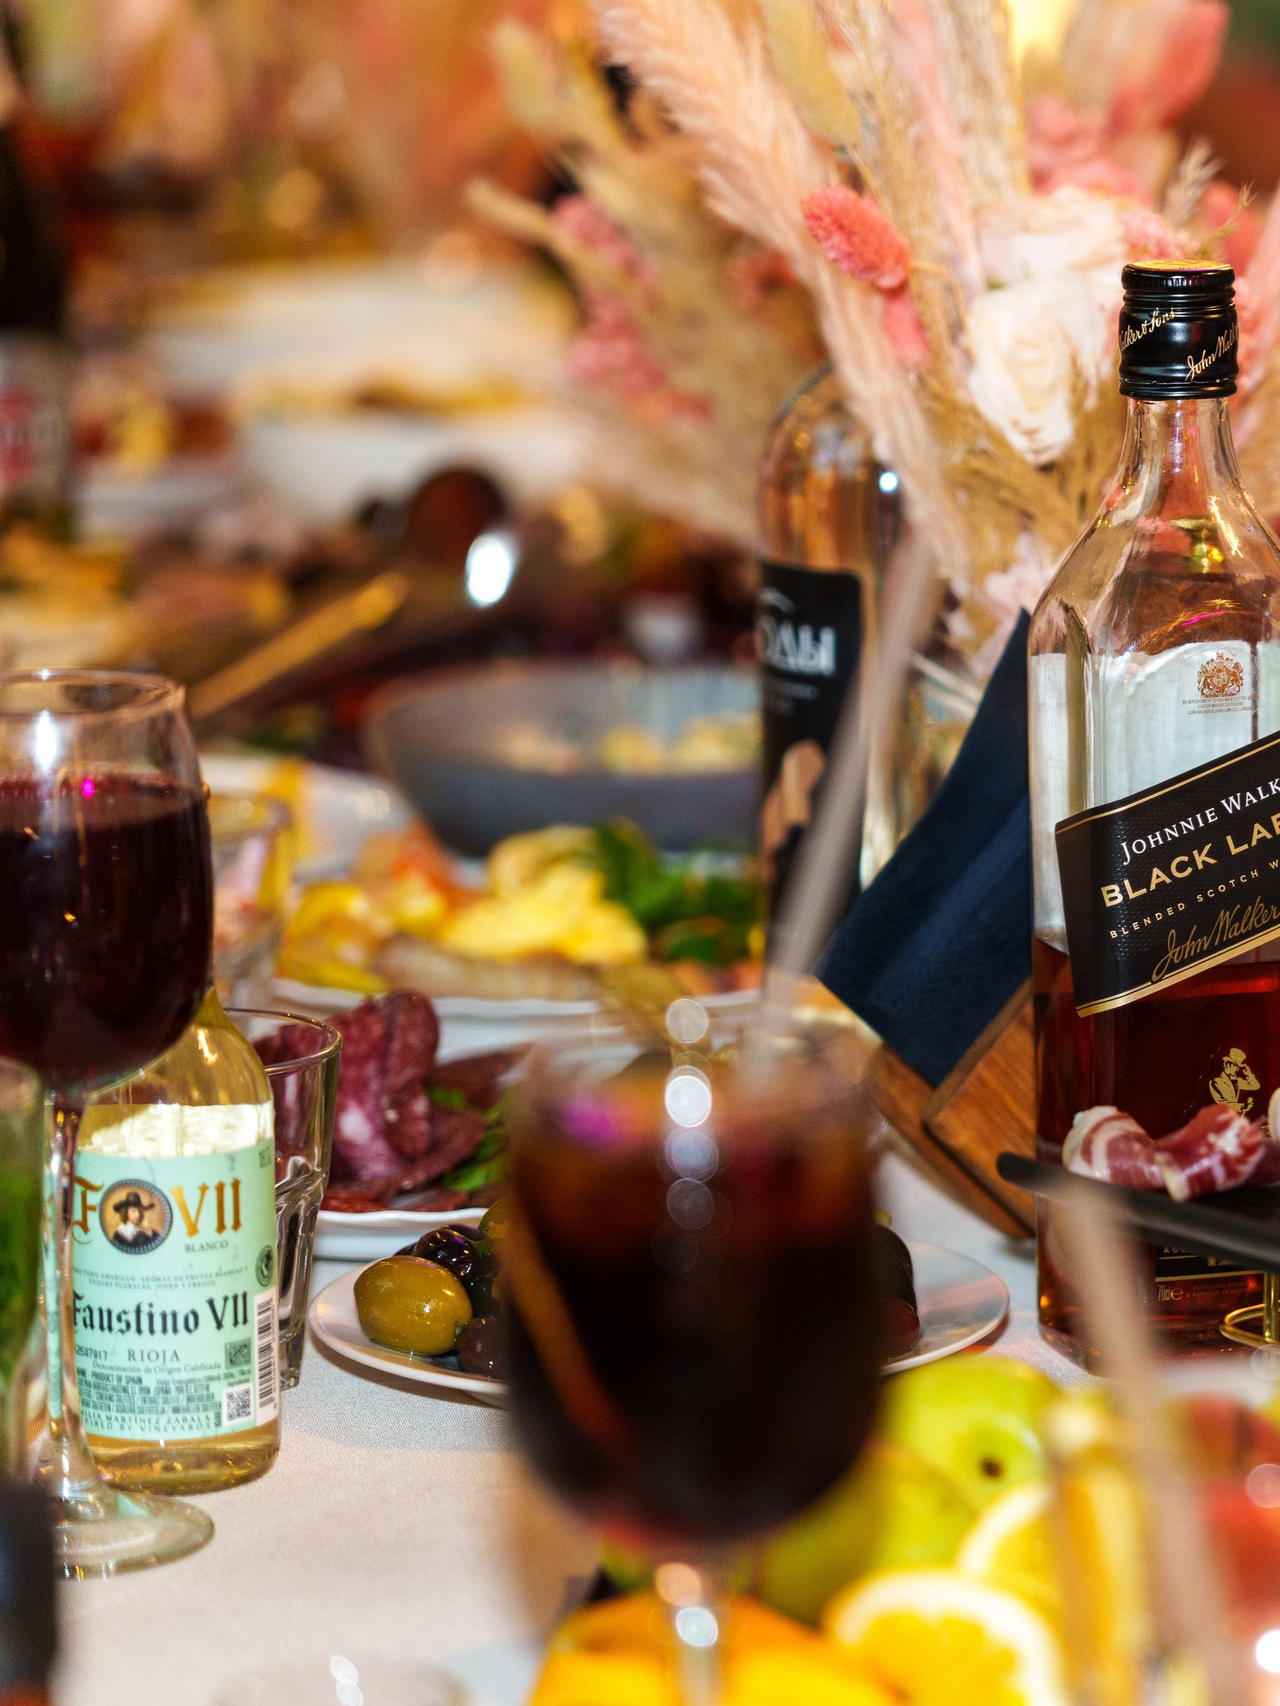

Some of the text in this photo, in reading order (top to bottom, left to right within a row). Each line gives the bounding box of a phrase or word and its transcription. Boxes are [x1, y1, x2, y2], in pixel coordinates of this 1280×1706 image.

[1120, 807, 1219, 865] JOHNNIE
[1100, 843, 1218, 908] BLACK
[1109, 902, 1186, 939] BLENDED
[1196, 869, 1259, 903] SCOTCH
[1152, 925, 1211, 983] John
[170, 1176, 242, 1239] VII
[184, 1240, 230, 1254] BLANCO
[73, 1289, 249, 1337] Faustino VII
[127, 1348, 181, 1366] RIOJA
[143, 1366, 153, 1374] de
[153, 1364, 182, 1376] Origen
[120, 1424, 133, 1432] BY
[140, 1421, 211, 1433] VINEYARDS
[167, 1413, 210, 1425] ZABALA
